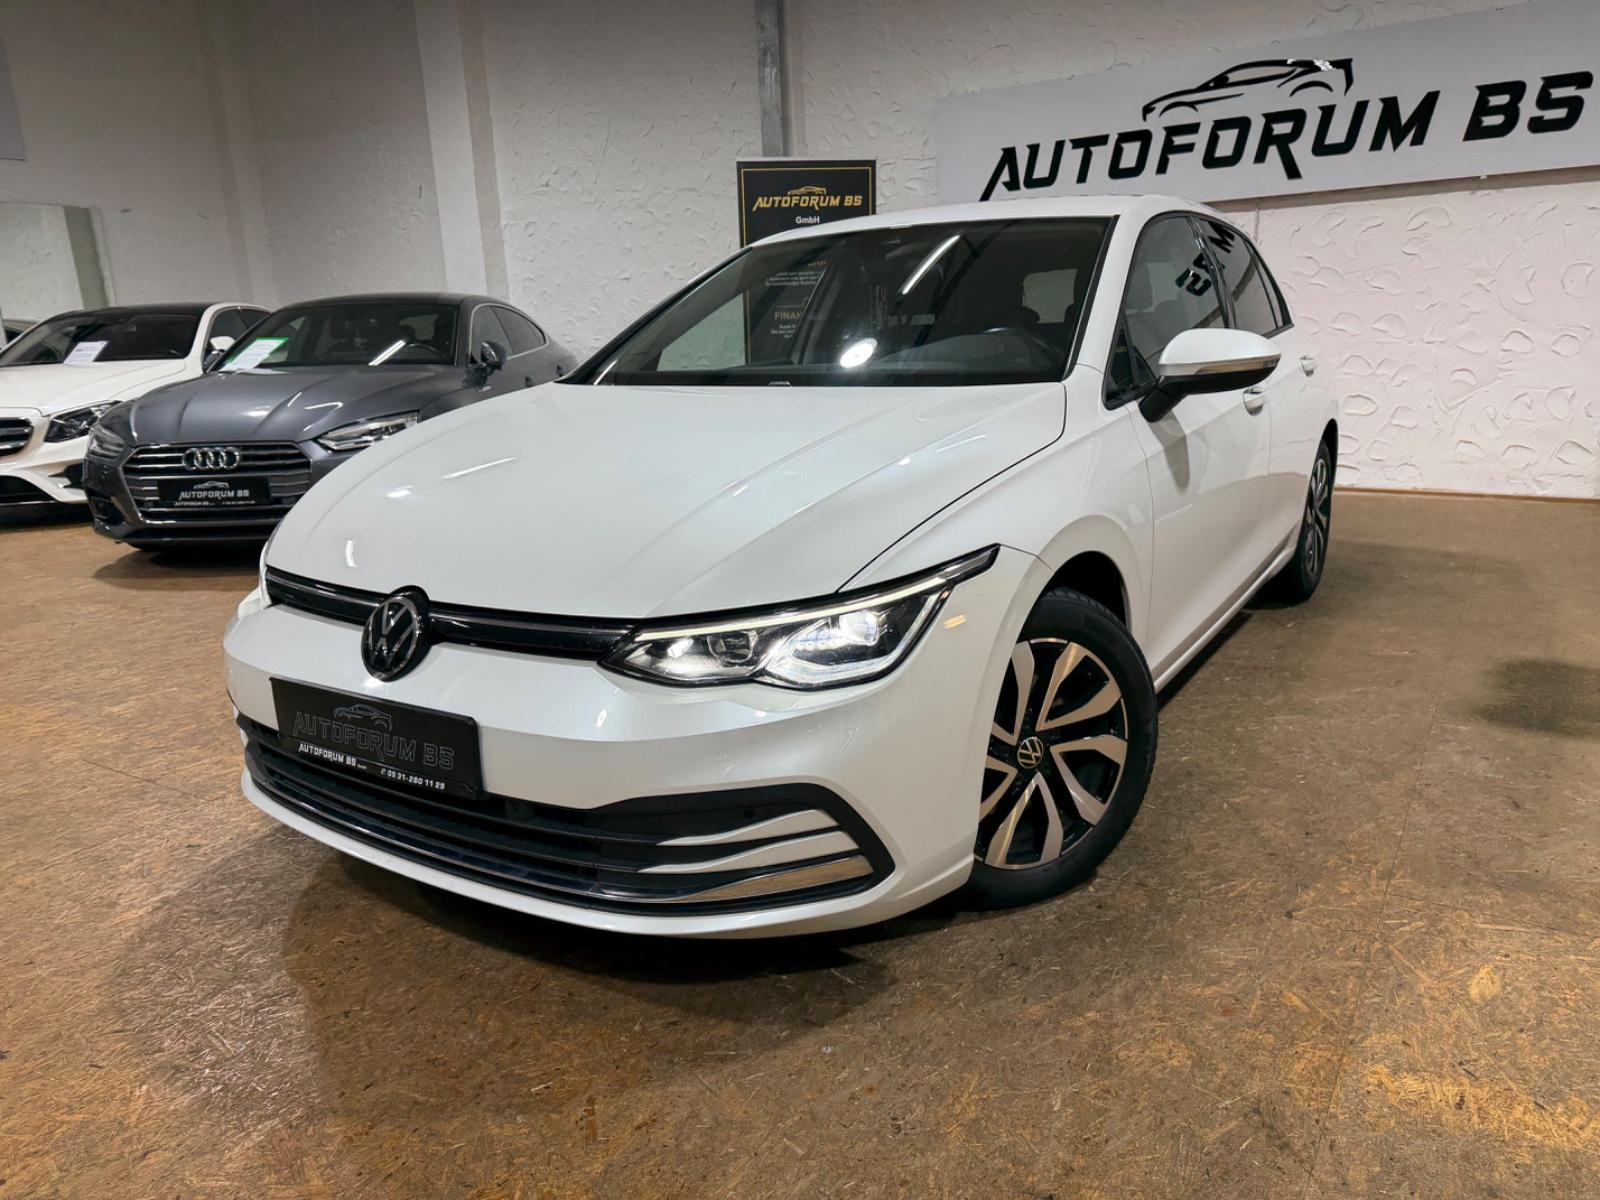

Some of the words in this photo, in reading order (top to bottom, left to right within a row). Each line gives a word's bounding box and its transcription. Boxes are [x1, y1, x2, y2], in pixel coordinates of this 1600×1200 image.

[979, 90, 1440, 201] AUTOFORUM
[1462, 71, 1594, 142] BS
[752, 196, 840, 212] AUTOFORUM
[844, 195, 863, 207] BS
[795, 216, 820, 225] GmbH
[178, 490, 234, 501] AUTOFORUM
[237, 489, 250, 498] BS
[292, 711, 416, 763] AUTOFORUM
[423, 743, 455, 770] BS
[298, 743, 344, 763] AUTOFORUM
